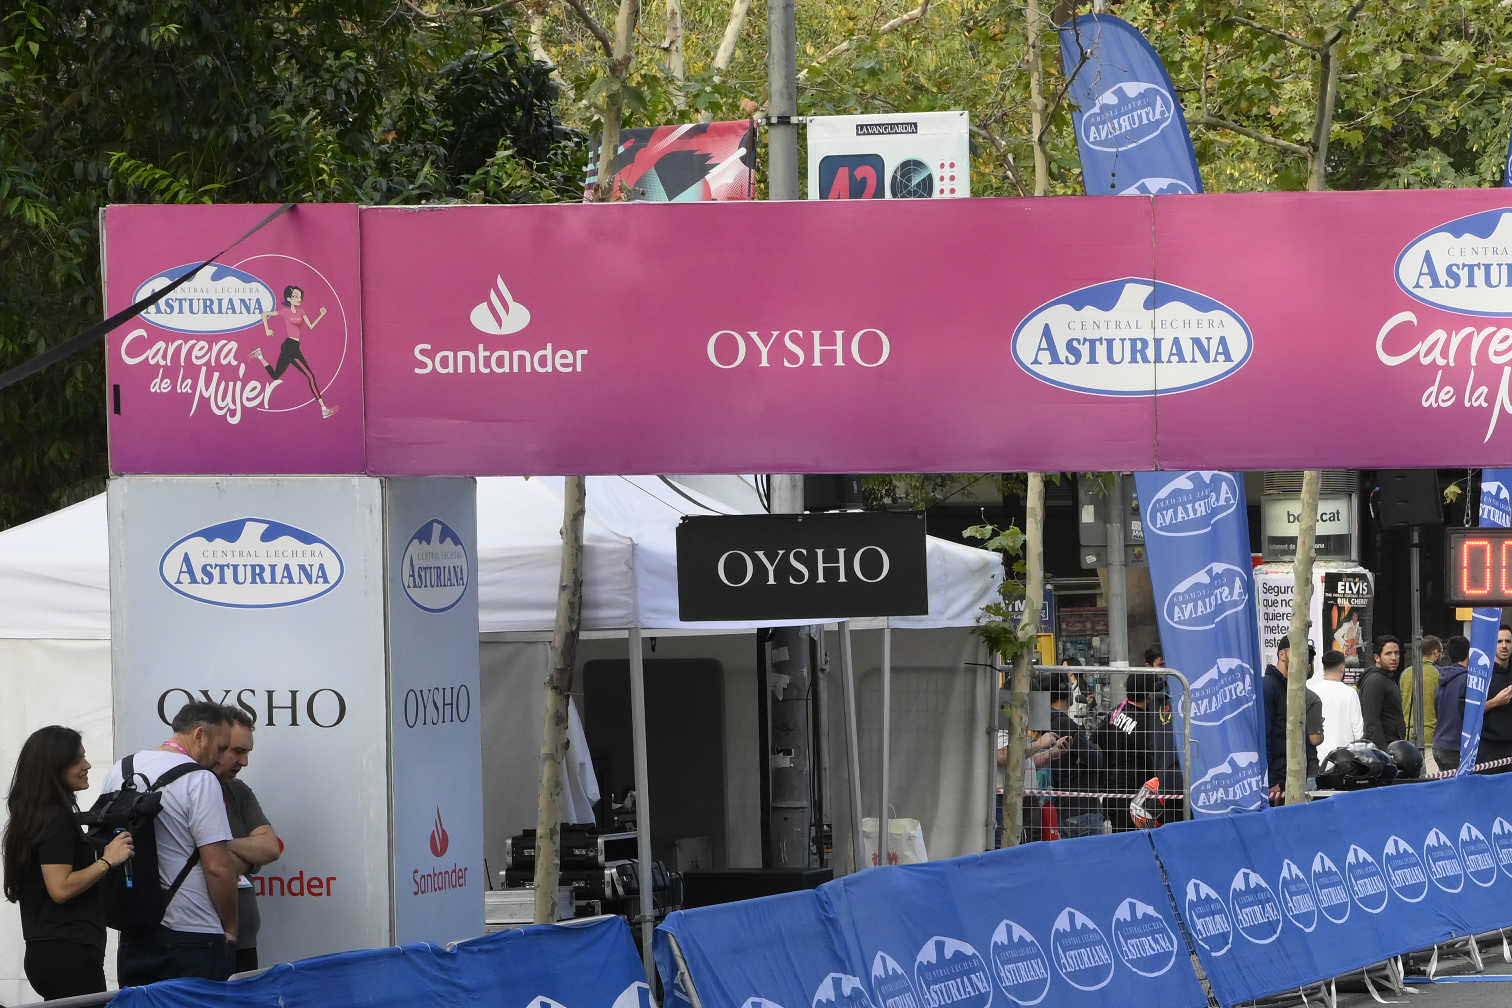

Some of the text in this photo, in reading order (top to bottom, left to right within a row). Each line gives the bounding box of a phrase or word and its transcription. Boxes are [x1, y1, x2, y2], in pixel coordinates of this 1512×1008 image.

[1067, 318, 1226, 331] CENTRAL LECHERA
[120, 328, 240, 367] Carrera
[413, 342, 588, 374] Santander
[706, 328, 891, 369] OYSHO
[1030, 322, 1234, 368] ASTURIANA
[151, 362, 283, 425] de la Mujer
[1421, 368, 1455, 408] de
[1464, 368, 1489, 408] la
[174, 551, 331, 586] ASTURIANA
[202, 549, 324, 558] CENTRAL LECHERA
[407, 553, 466, 588] ASTURIANA
[717, 545, 890, 587] OYSHO
[1337, 582, 1368, 594] ELVIS
[404, 684, 471, 729] OYSHO
[254, 870, 337, 897] ander
[412, 863, 468, 896] Santander
[1057, 941, 1111, 973] ASTURIANA
